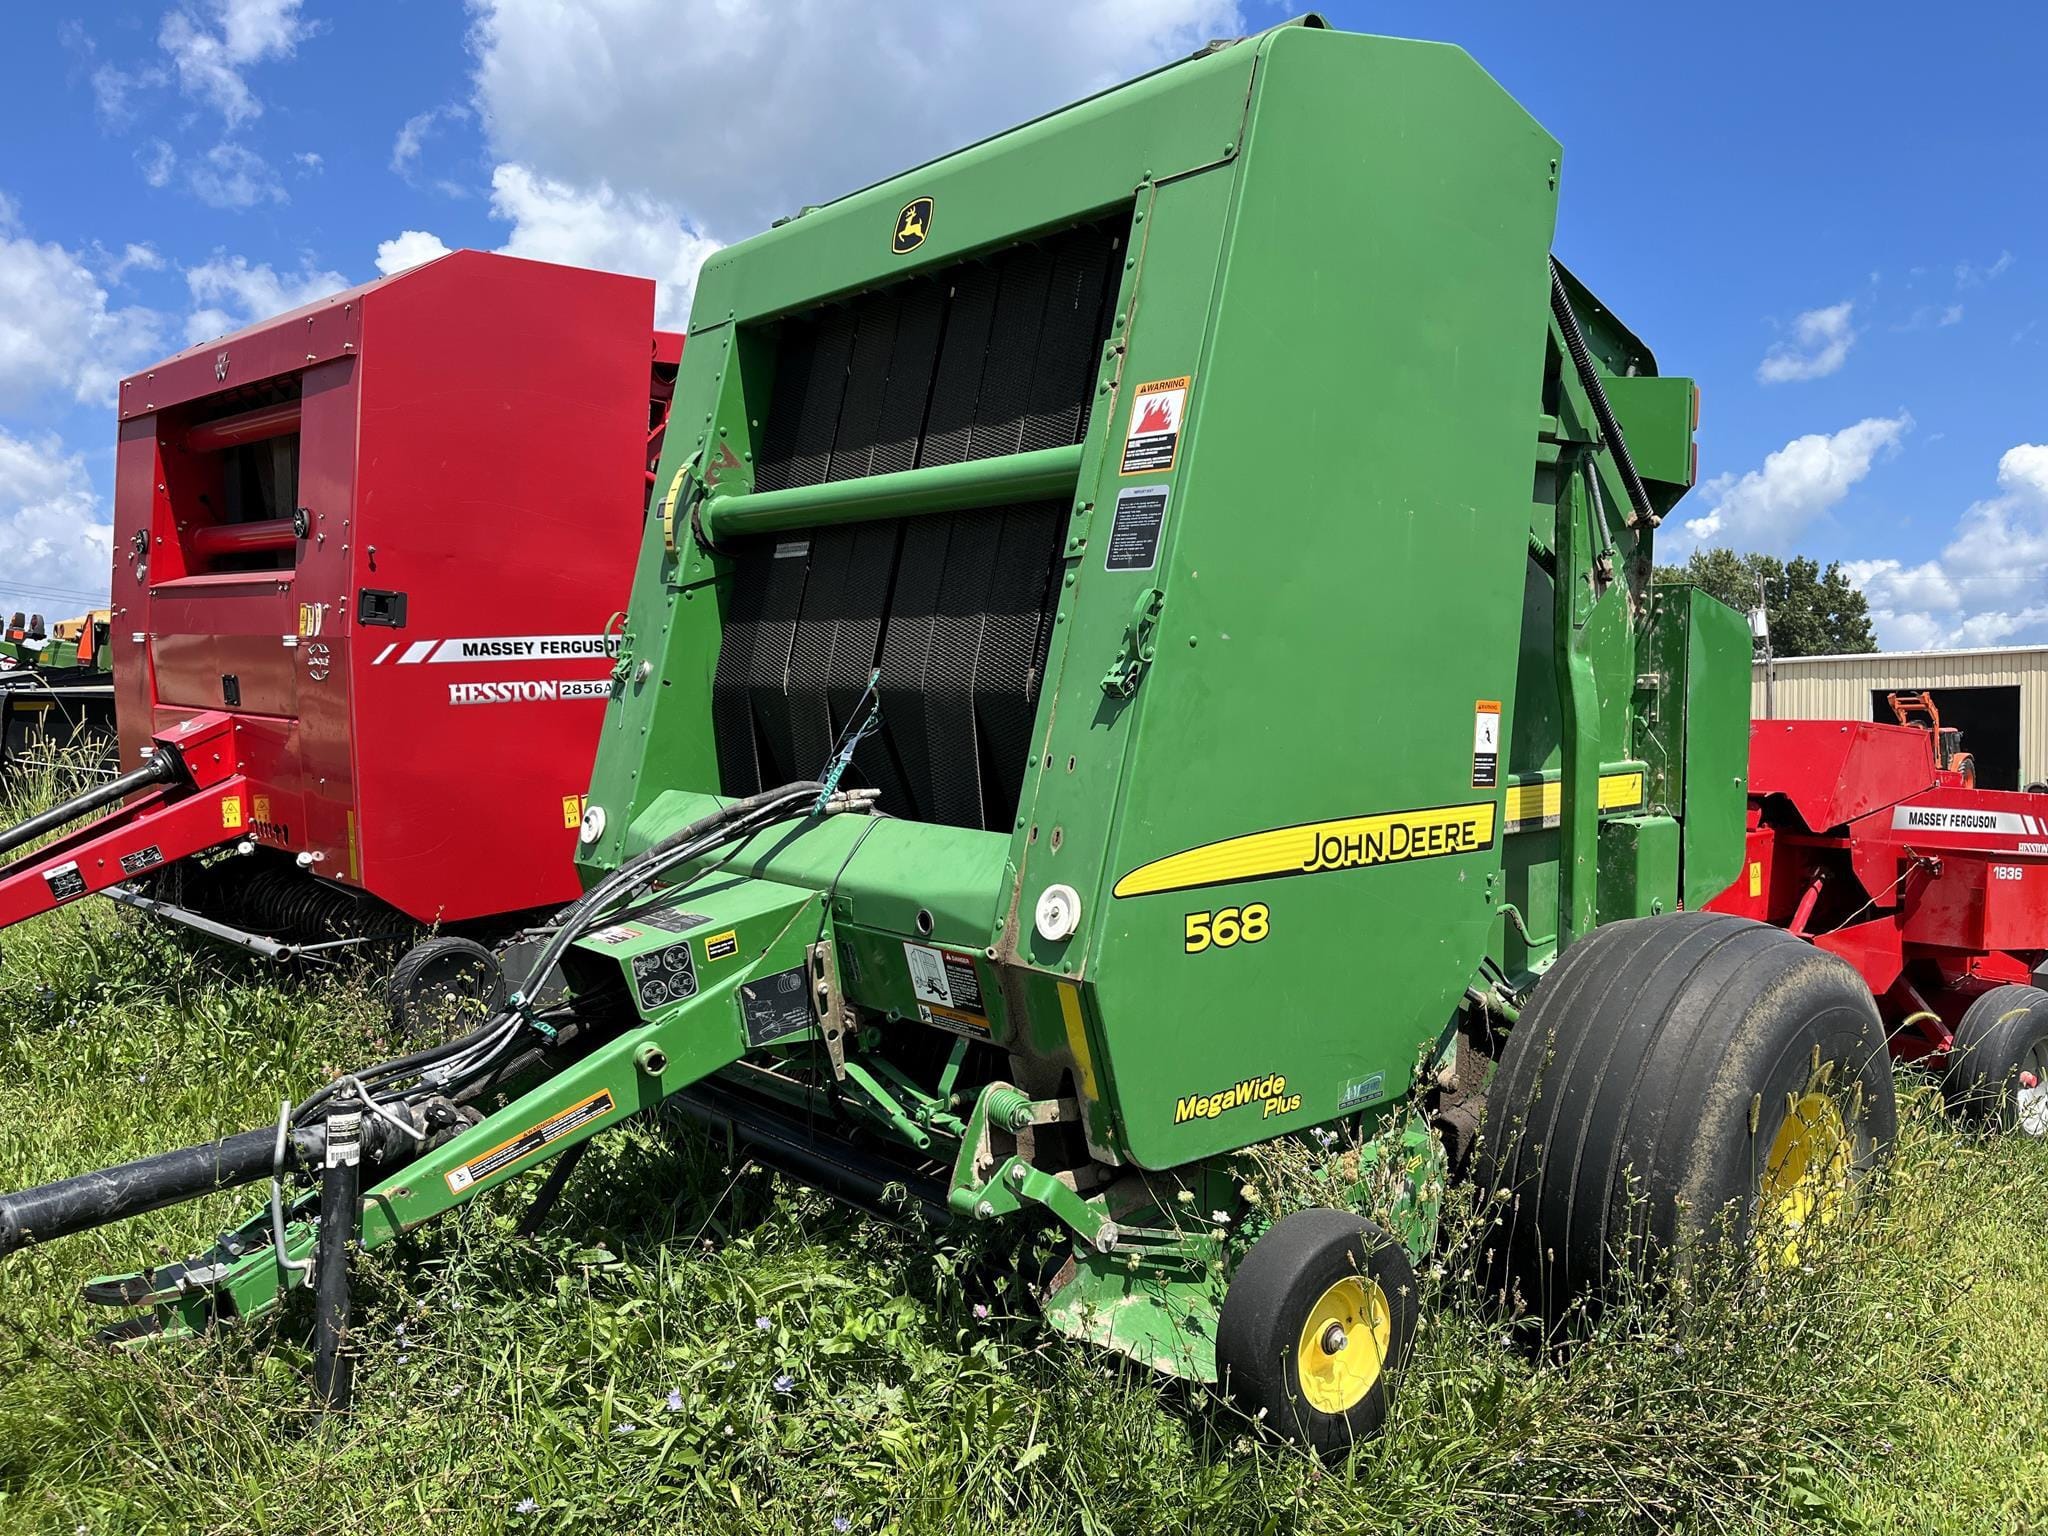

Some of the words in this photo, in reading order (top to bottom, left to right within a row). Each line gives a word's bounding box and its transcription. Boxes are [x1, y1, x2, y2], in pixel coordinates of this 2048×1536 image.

[1147, 379, 1184, 393] WARNING
[463, 642, 534, 656] MASSEY
[448, 680, 558, 705] HESSTON
[1909, 812, 1947, 826] MASSEY
[1950, 815, 1997, 829] FERGUSON
[1303, 830, 1383, 867] JOHN
[1389, 821, 1476, 856] DEERE
[1993, 866, 2023, 880] 1836
[1185, 902, 1270, 954] 568
[1174, 1072, 1286, 1125] MegaWide
[1262, 1094, 1301, 1120] Plus
